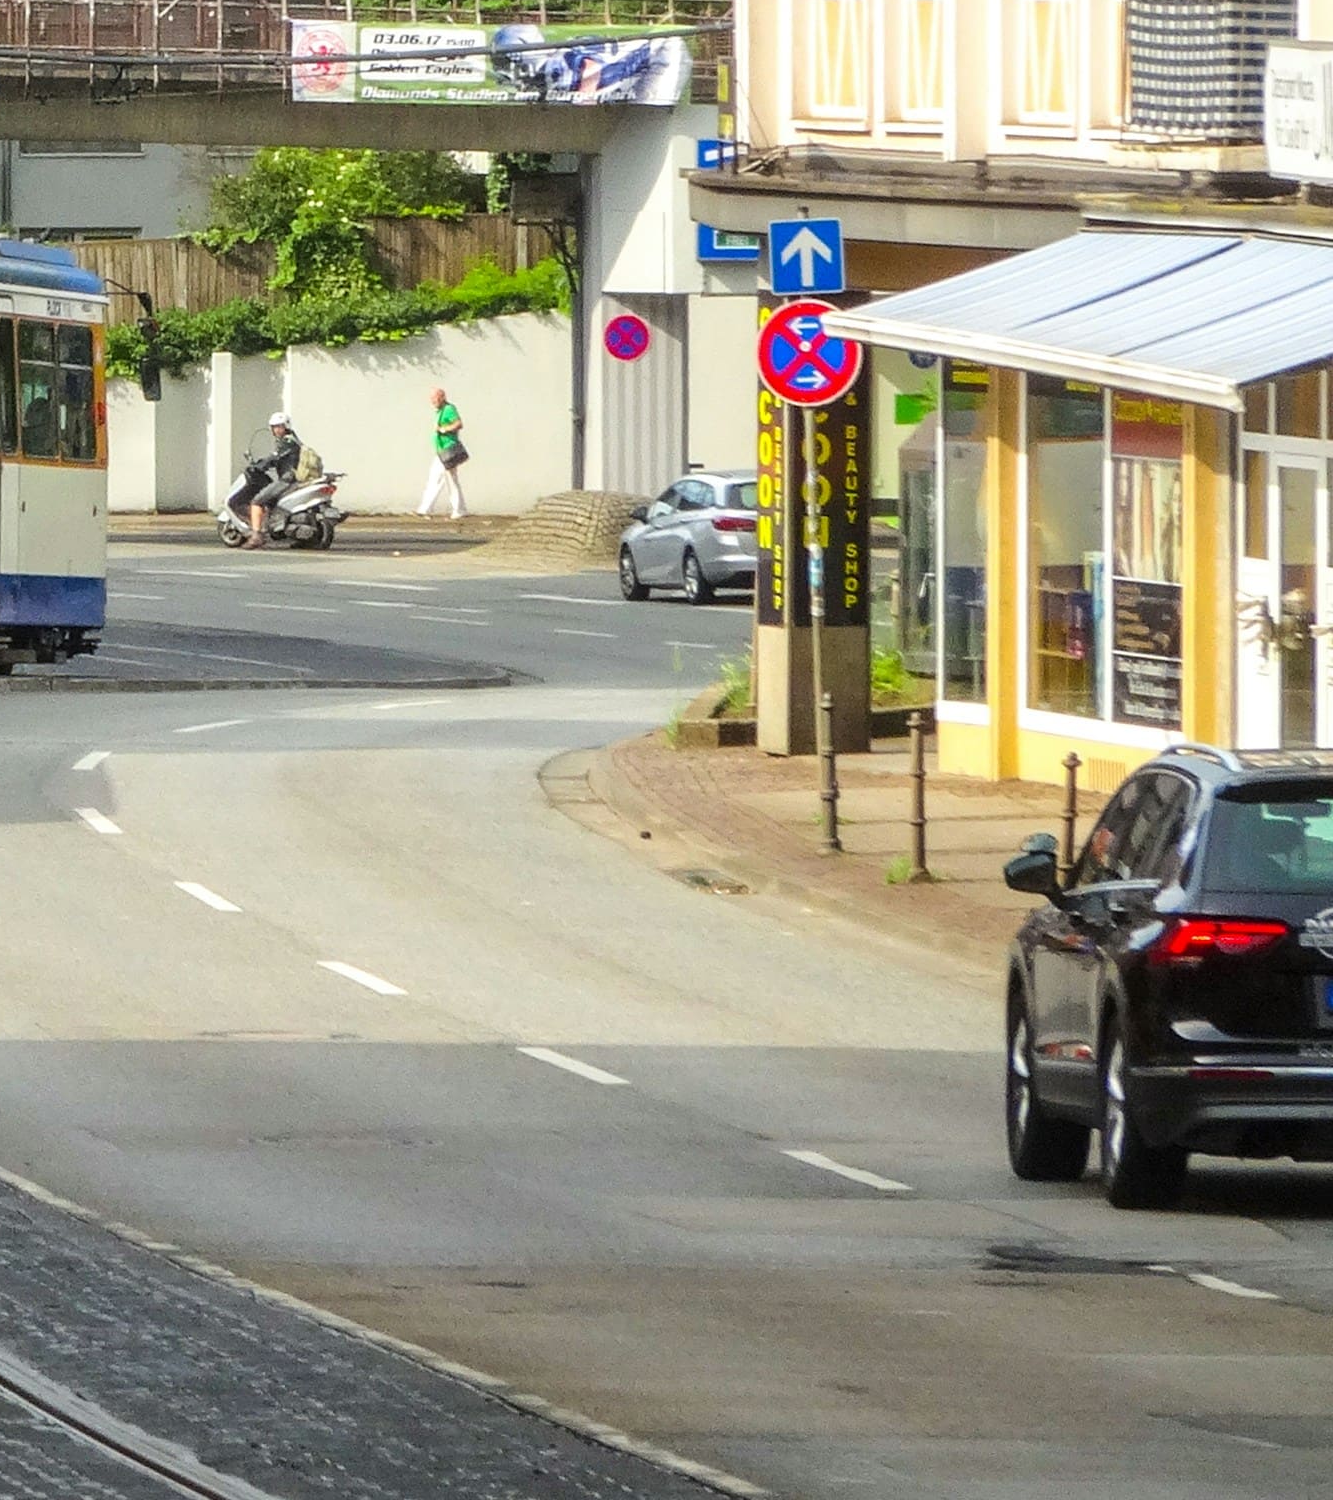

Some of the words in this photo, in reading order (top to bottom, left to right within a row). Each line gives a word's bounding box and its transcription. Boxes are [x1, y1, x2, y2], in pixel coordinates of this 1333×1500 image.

[373, 33, 441, 46] 03.06.17
[425, 64, 473, 76] Eagles
[845, 425, 858, 525] BEAUTY
[844, 543, 858, 609] SHOP
